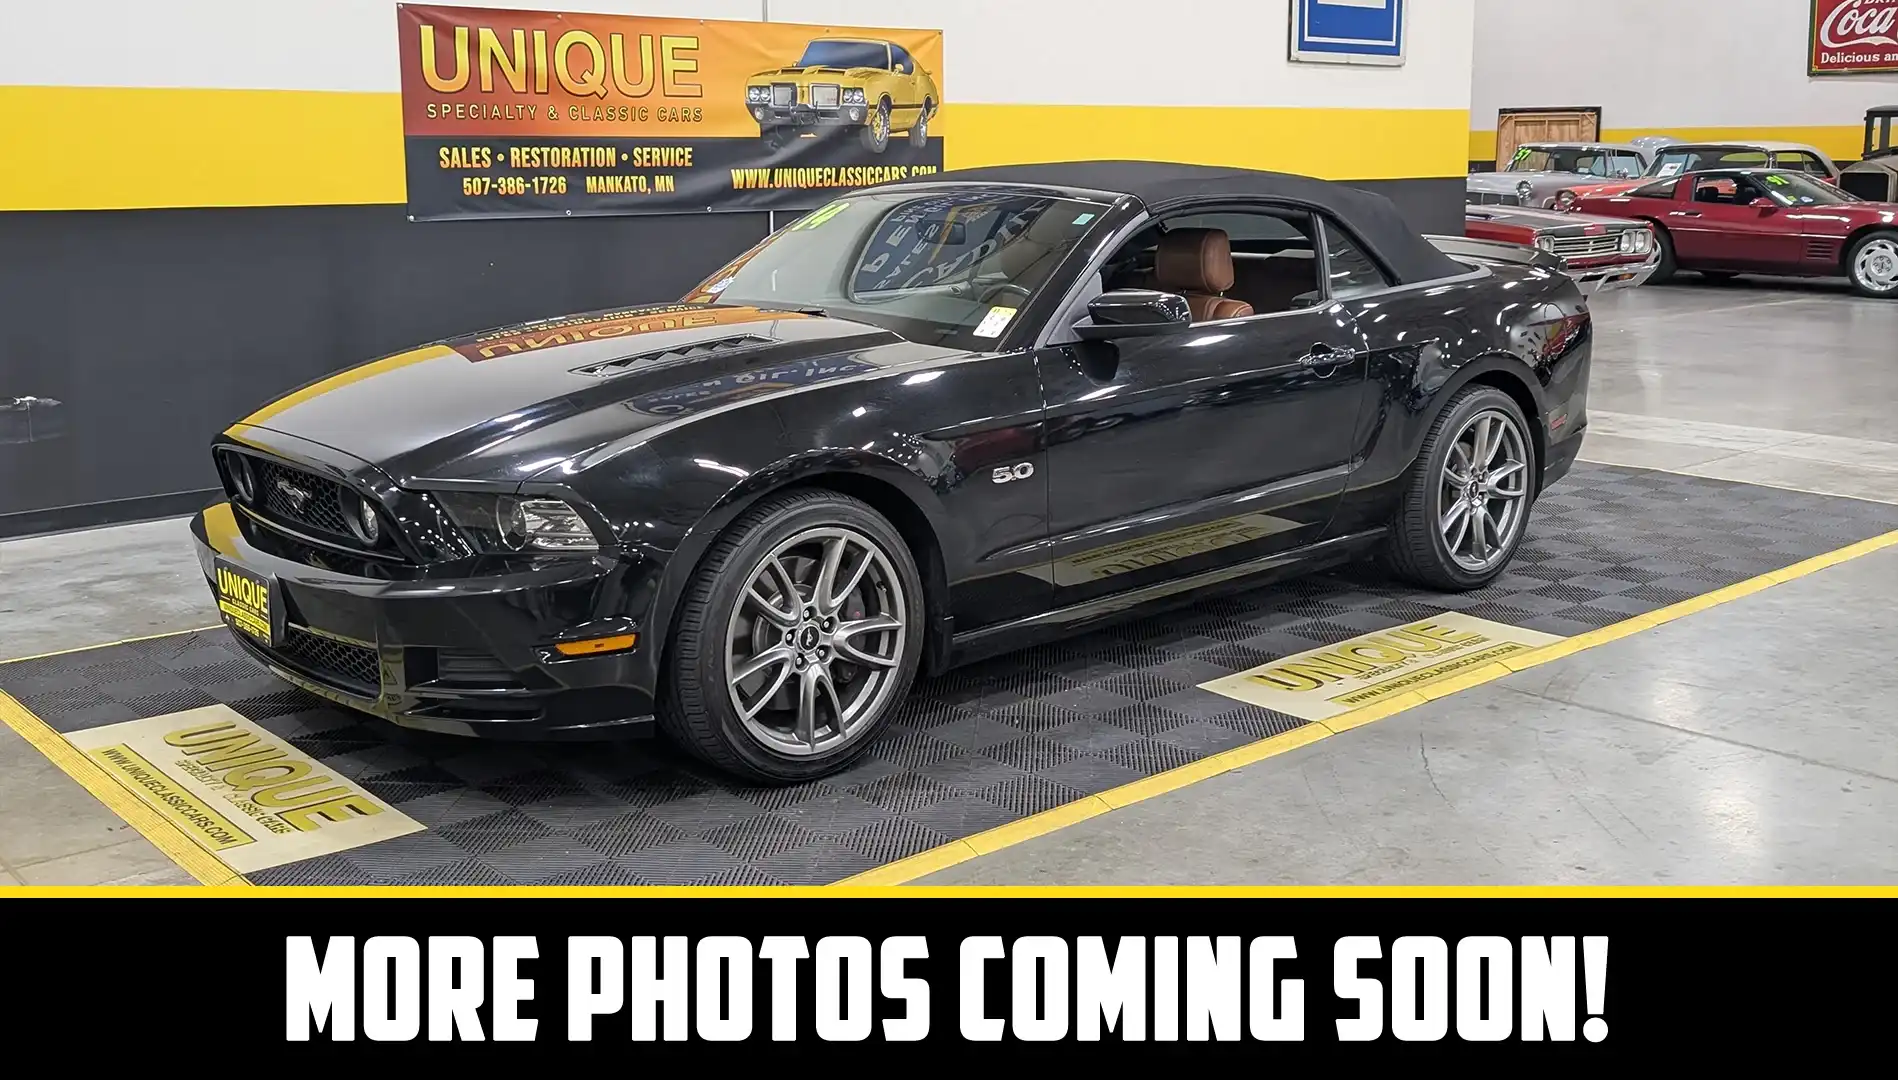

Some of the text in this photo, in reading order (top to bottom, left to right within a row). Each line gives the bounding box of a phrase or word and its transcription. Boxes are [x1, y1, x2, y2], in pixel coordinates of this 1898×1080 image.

[1820, 0, 1898, 47] Coca
[419, 24, 703, 99] UNIQUE
[1821, 52, 1880, 63] Delicious
[427, 103, 703, 122] SPECIALTY & CLASSIC CARS
[439, 147, 693, 168] SALES RESTORATION SERVICE
[463, 176, 567, 195] 507-386-1726
[586, 175, 675, 194] MANKATO, MN
[731, 165, 937, 190] WWW.UNIQUECLASSICCARSCO
[217, 568, 268, 614] UNIQUE
[1244, 623, 1483, 691] UNIQUE
[163, 720, 387, 832] UNIQUE
[102, 748, 238, 845] WWW.UNIQUECLASSICCARS.COM
